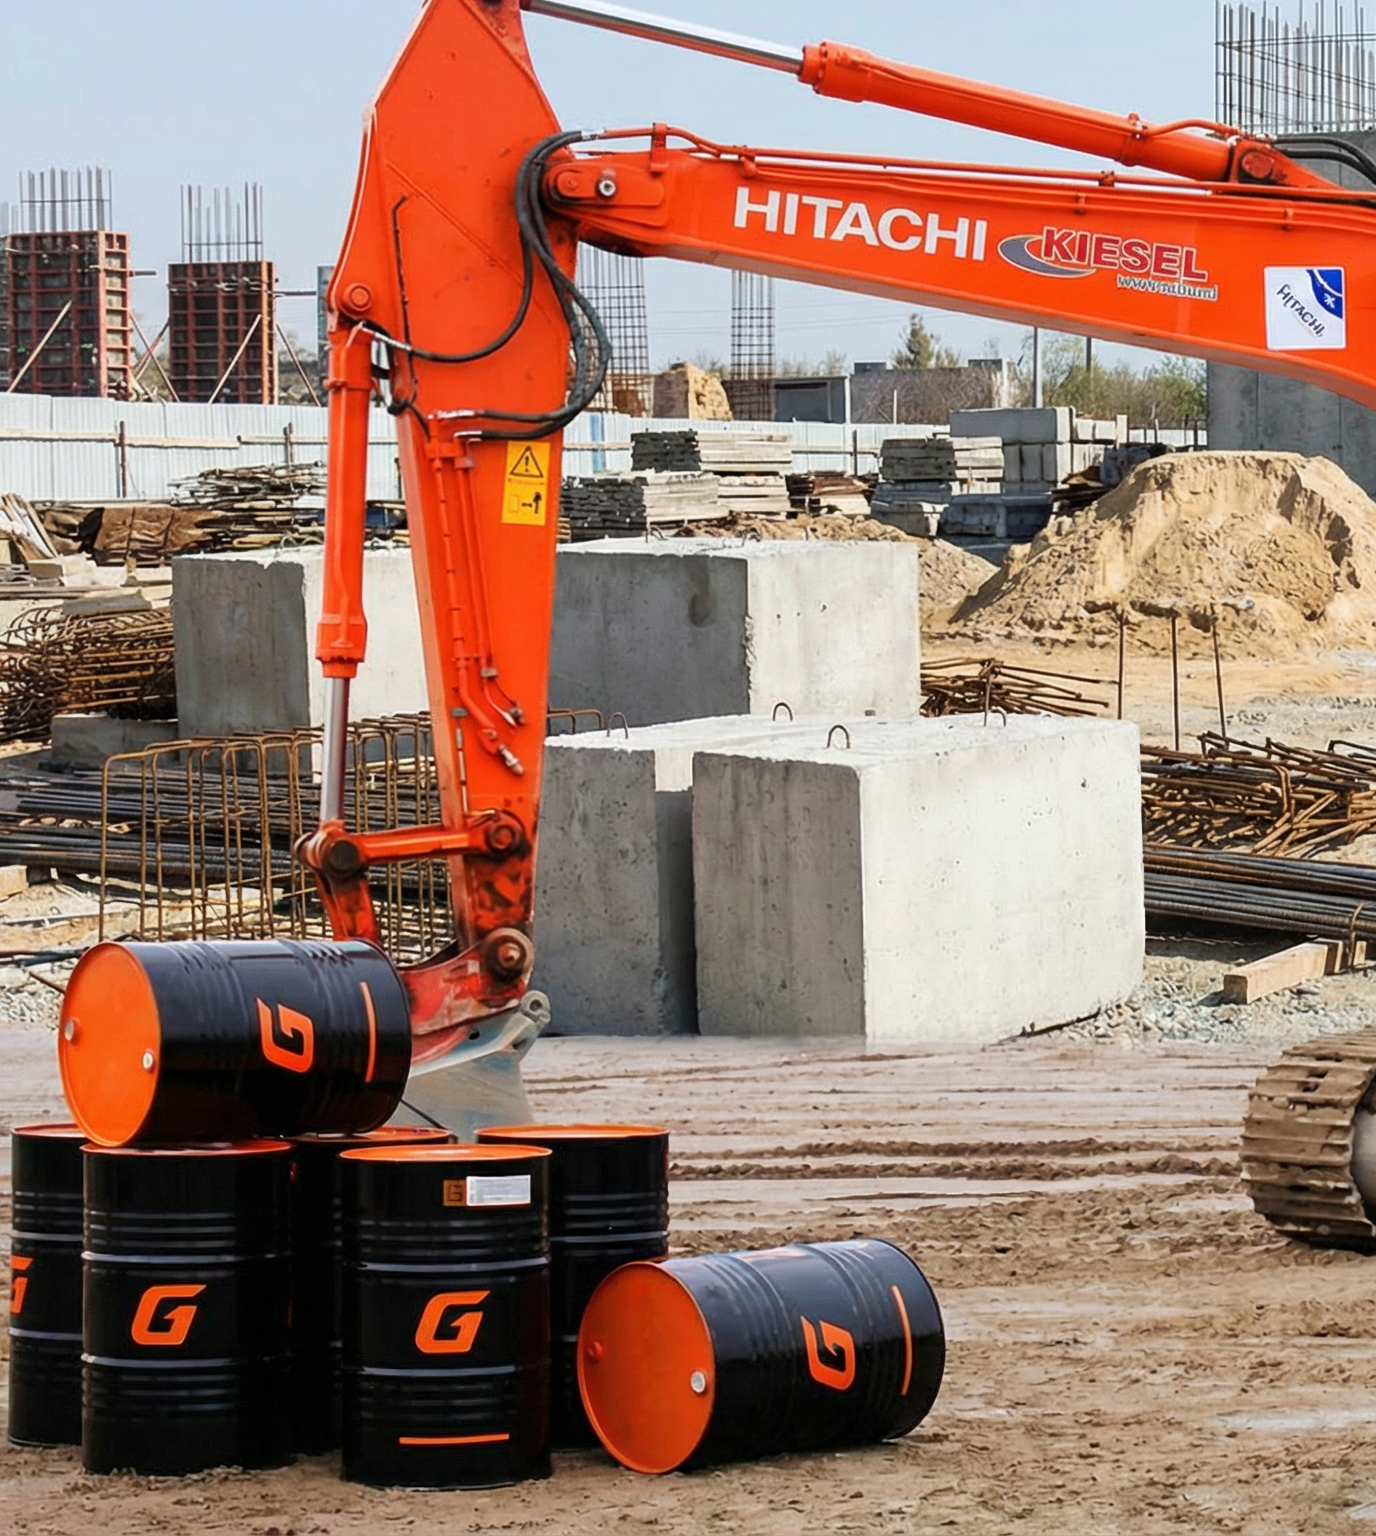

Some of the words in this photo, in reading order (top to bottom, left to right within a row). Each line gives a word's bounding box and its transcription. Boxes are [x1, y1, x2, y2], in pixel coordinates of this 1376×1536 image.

[734, 187, 987, 261] HITACHI
[1042, 227, 1208, 281] KIESEL
[257, 998, 314, 1073] G
[131, 1285, 206, 1345] G
[414, 1290, 490, 1354] G
[801, 1315, 856, 1390] G
